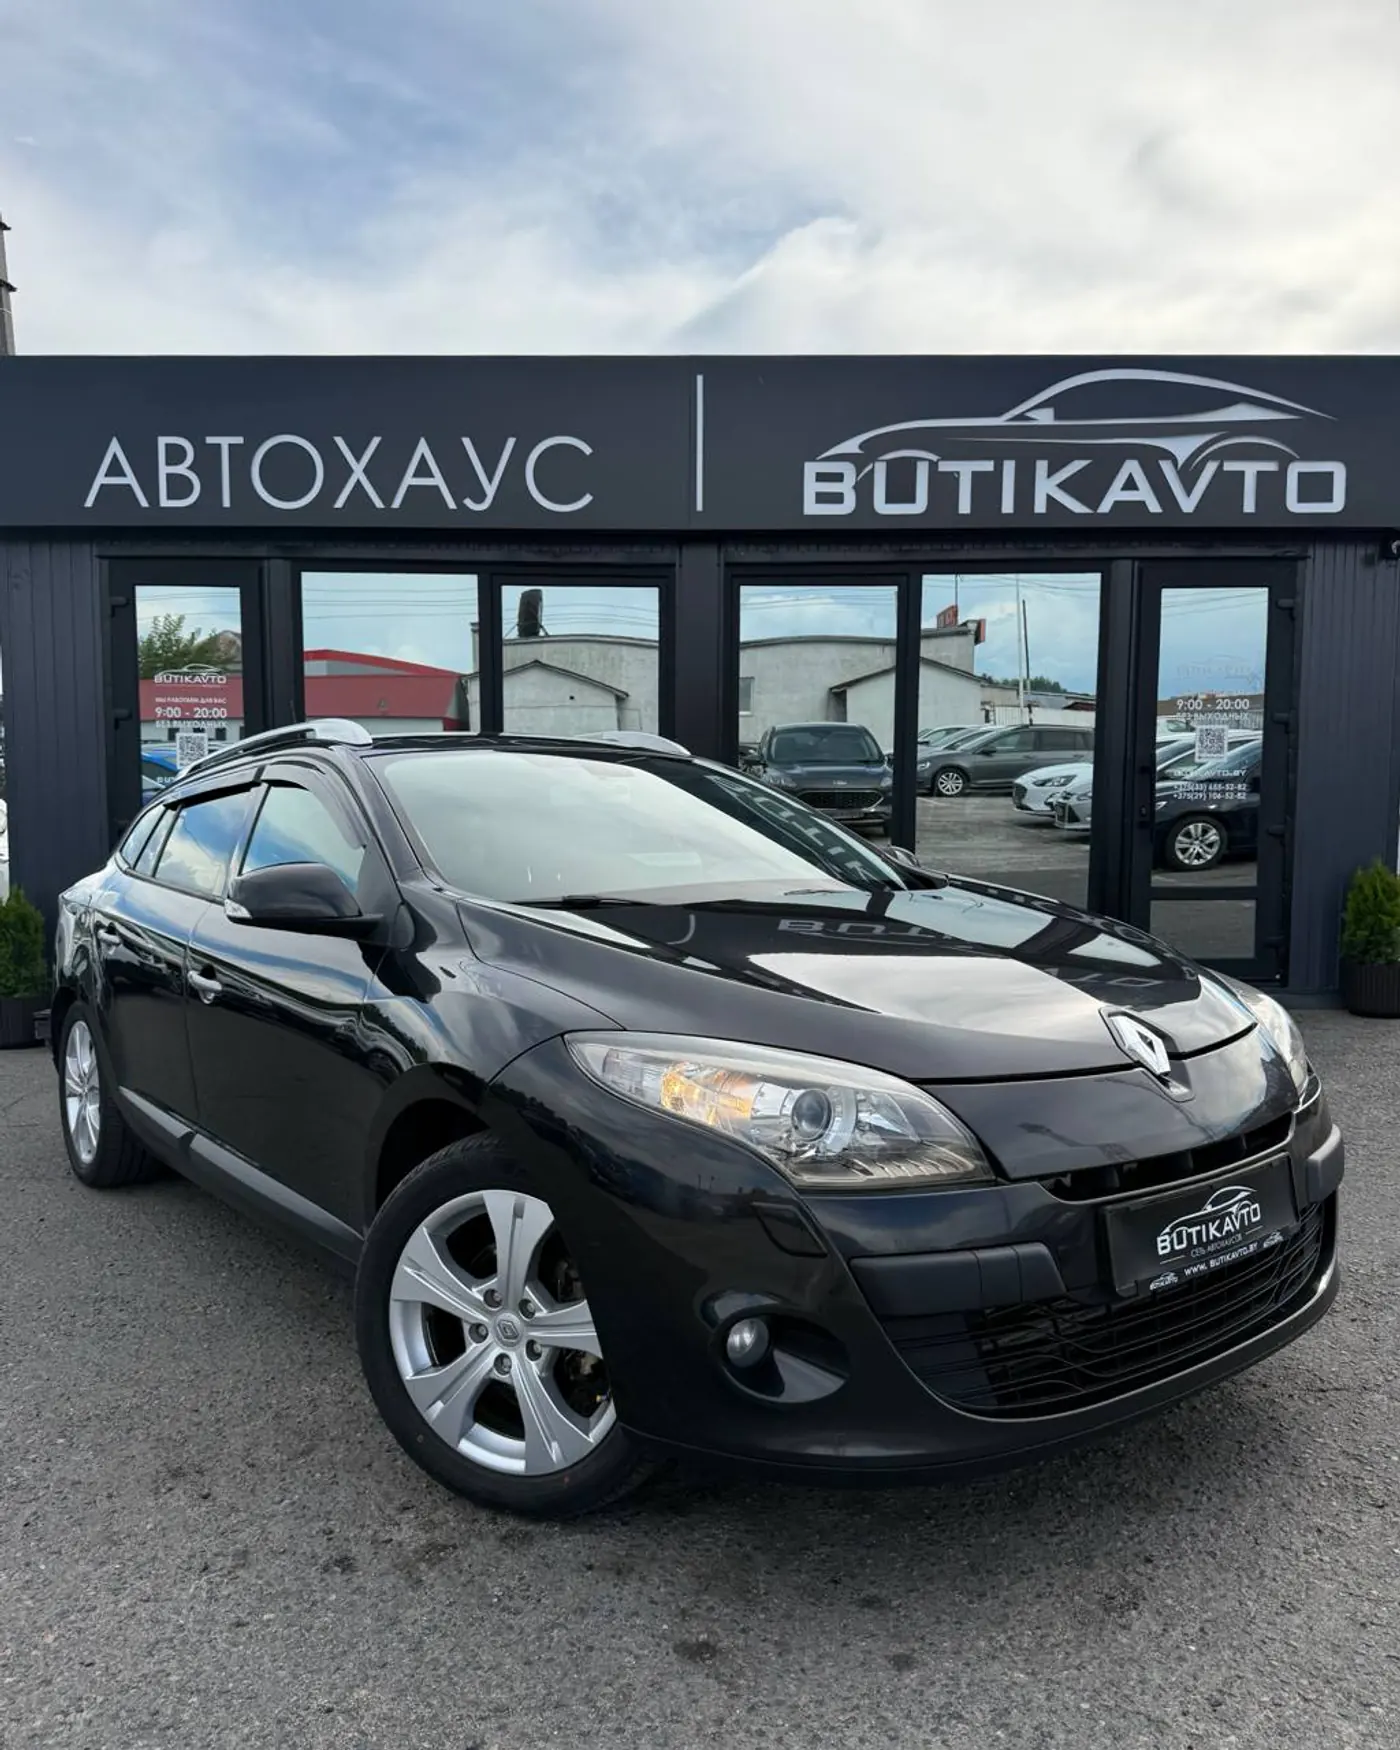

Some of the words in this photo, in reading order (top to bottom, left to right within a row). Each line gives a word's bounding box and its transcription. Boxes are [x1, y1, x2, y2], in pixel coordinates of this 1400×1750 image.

[84, 434, 593, 512] АВТОХАУС
[803, 460, 1347, 515] BUTIKAVTO
[154, 675, 227, 684] BUTIKAVTO
[1176, 699, 1203, 710] 9:00
[1215, 699, 1250, 710] 20:00
[155, 706, 182, 718] 9:00
[193, 707, 228, 719] 20:00
[1173, 769, 1247, 777] AVTO.BY
[1156, 1203, 1262, 1255] BUTIKAVTO
